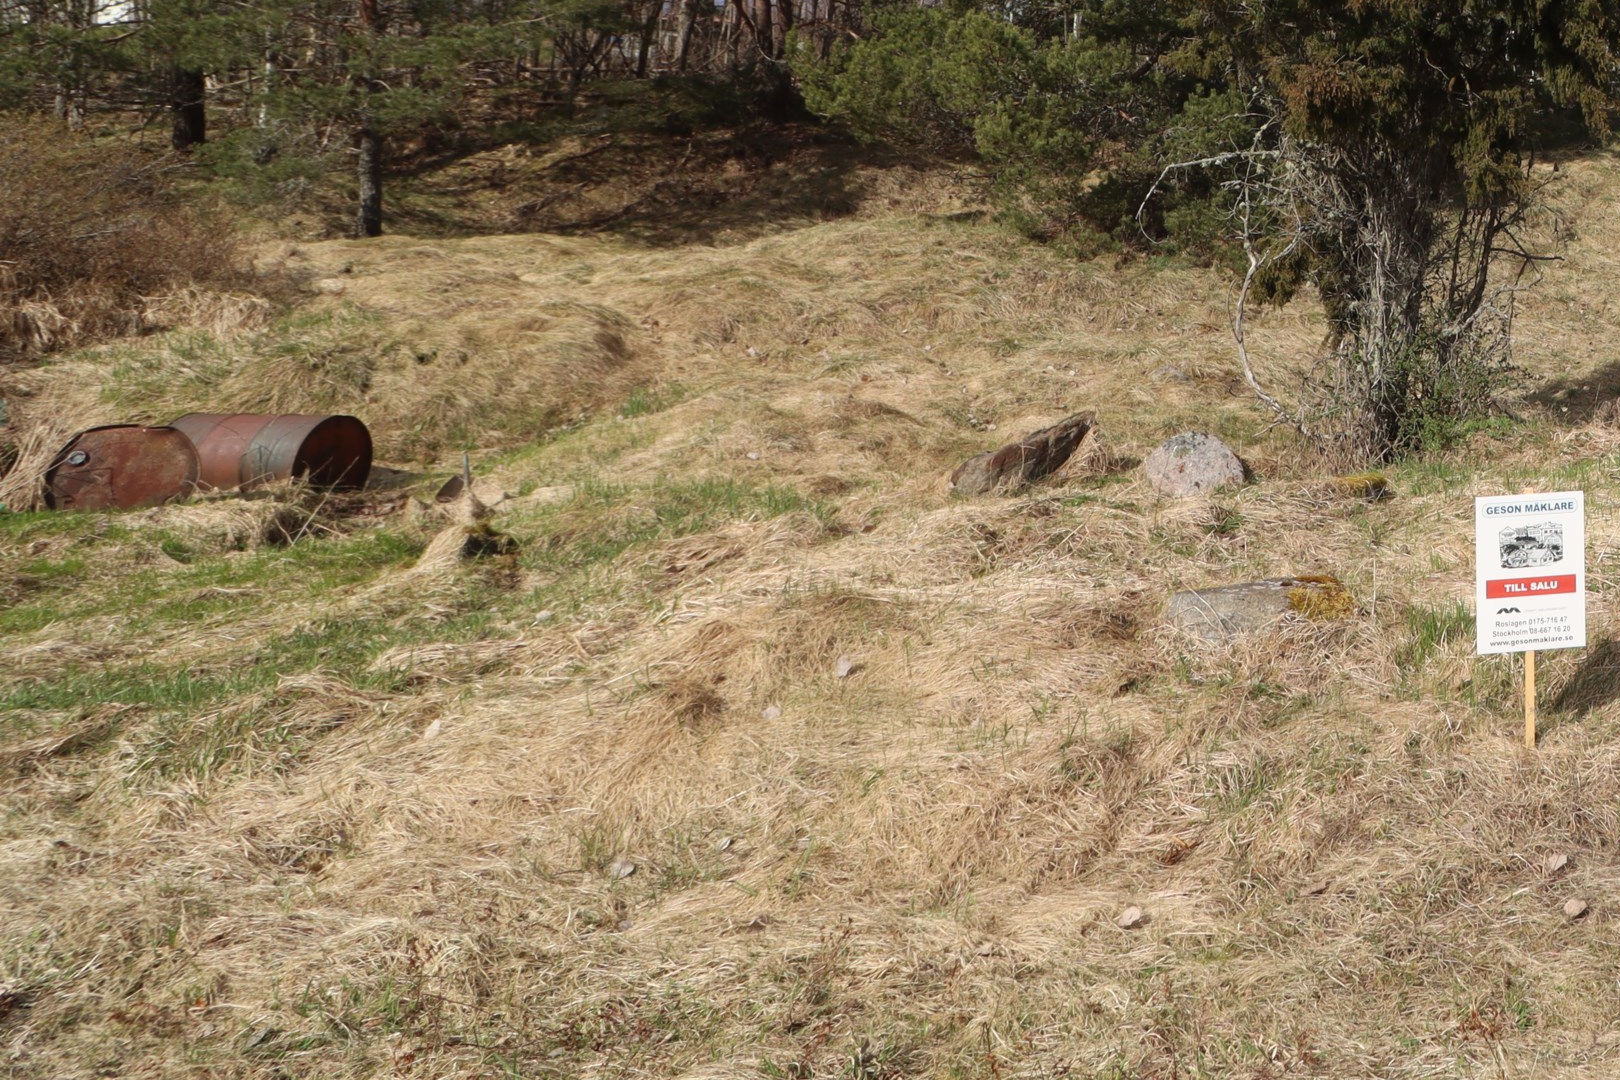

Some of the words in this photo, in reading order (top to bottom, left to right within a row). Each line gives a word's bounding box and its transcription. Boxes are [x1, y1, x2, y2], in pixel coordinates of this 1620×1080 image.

[1487, 506, 1521, 514] GESON
[1525, 502, 1574, 512] MÄKLARE
[1504, 584, 1527, 592] TILL
[1531, 581, 1557, 590] SALU
[1496, 620, 1526, 628] Roslagen
[1528, 617, 1558, 625] 0175-716
[1493, 629, 1528, 637] Stockholm
[1490, 635, 1573, 646] www.gesonmaklare.se
